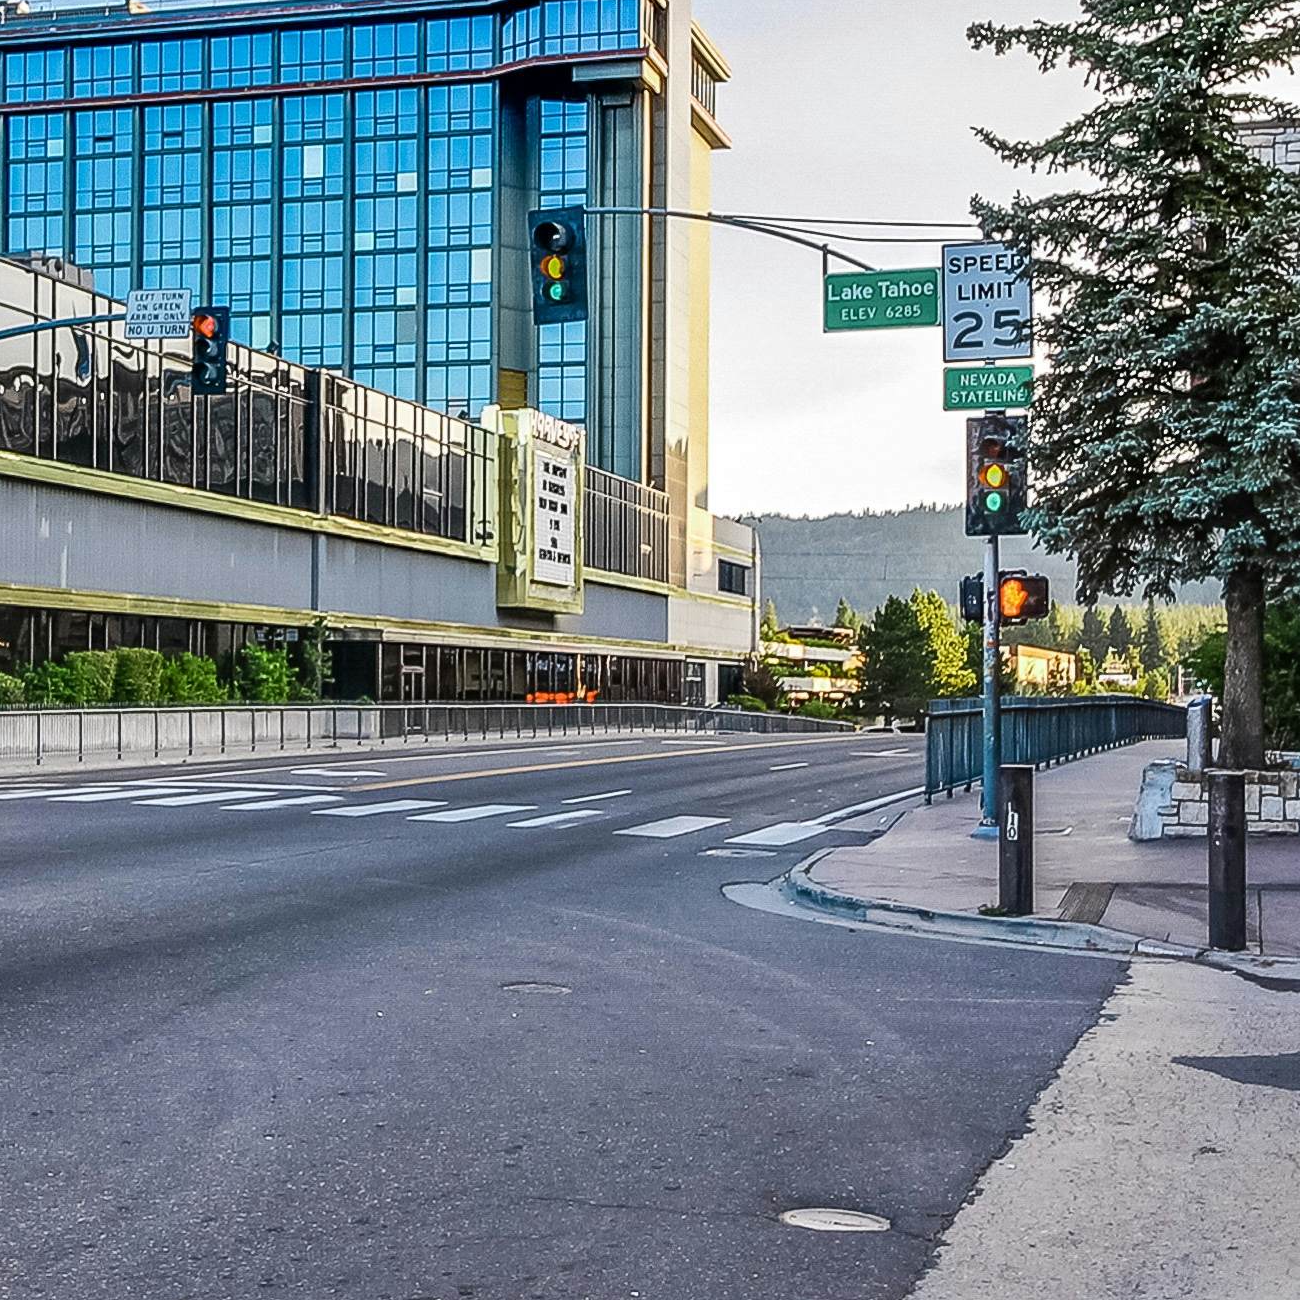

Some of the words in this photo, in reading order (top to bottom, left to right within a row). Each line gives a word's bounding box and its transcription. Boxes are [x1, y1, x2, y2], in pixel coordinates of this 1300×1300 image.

[948, 253, 1025, 274] SPEED
[135, 293, 155, 301] LEFT
[162, 293, 184, 301] TURN
[827, 283, 874, 301] Lake
[878, 280, 934, 298] Tahoe
[957, 281, 1016, 301] LIMIT
[136, 303, 148, 311] ON
[153, 302, 181, 311] GREEN
[841, 307, 877, 321] ELEV
[885, 304, 921, 318] 6285
[130, 313, 159, 321] ARROW
[163, 312, 185, 321] ONLY
[128, 325, 143, 335] NO
[147, 325, 154, 335] U
[160, 324, 186, 335] TURN
[952, 309, 1024, 349] 25
[960, 372, 1017, 386] NEVADA
[951, 389, 1026, 404] STATELINE
